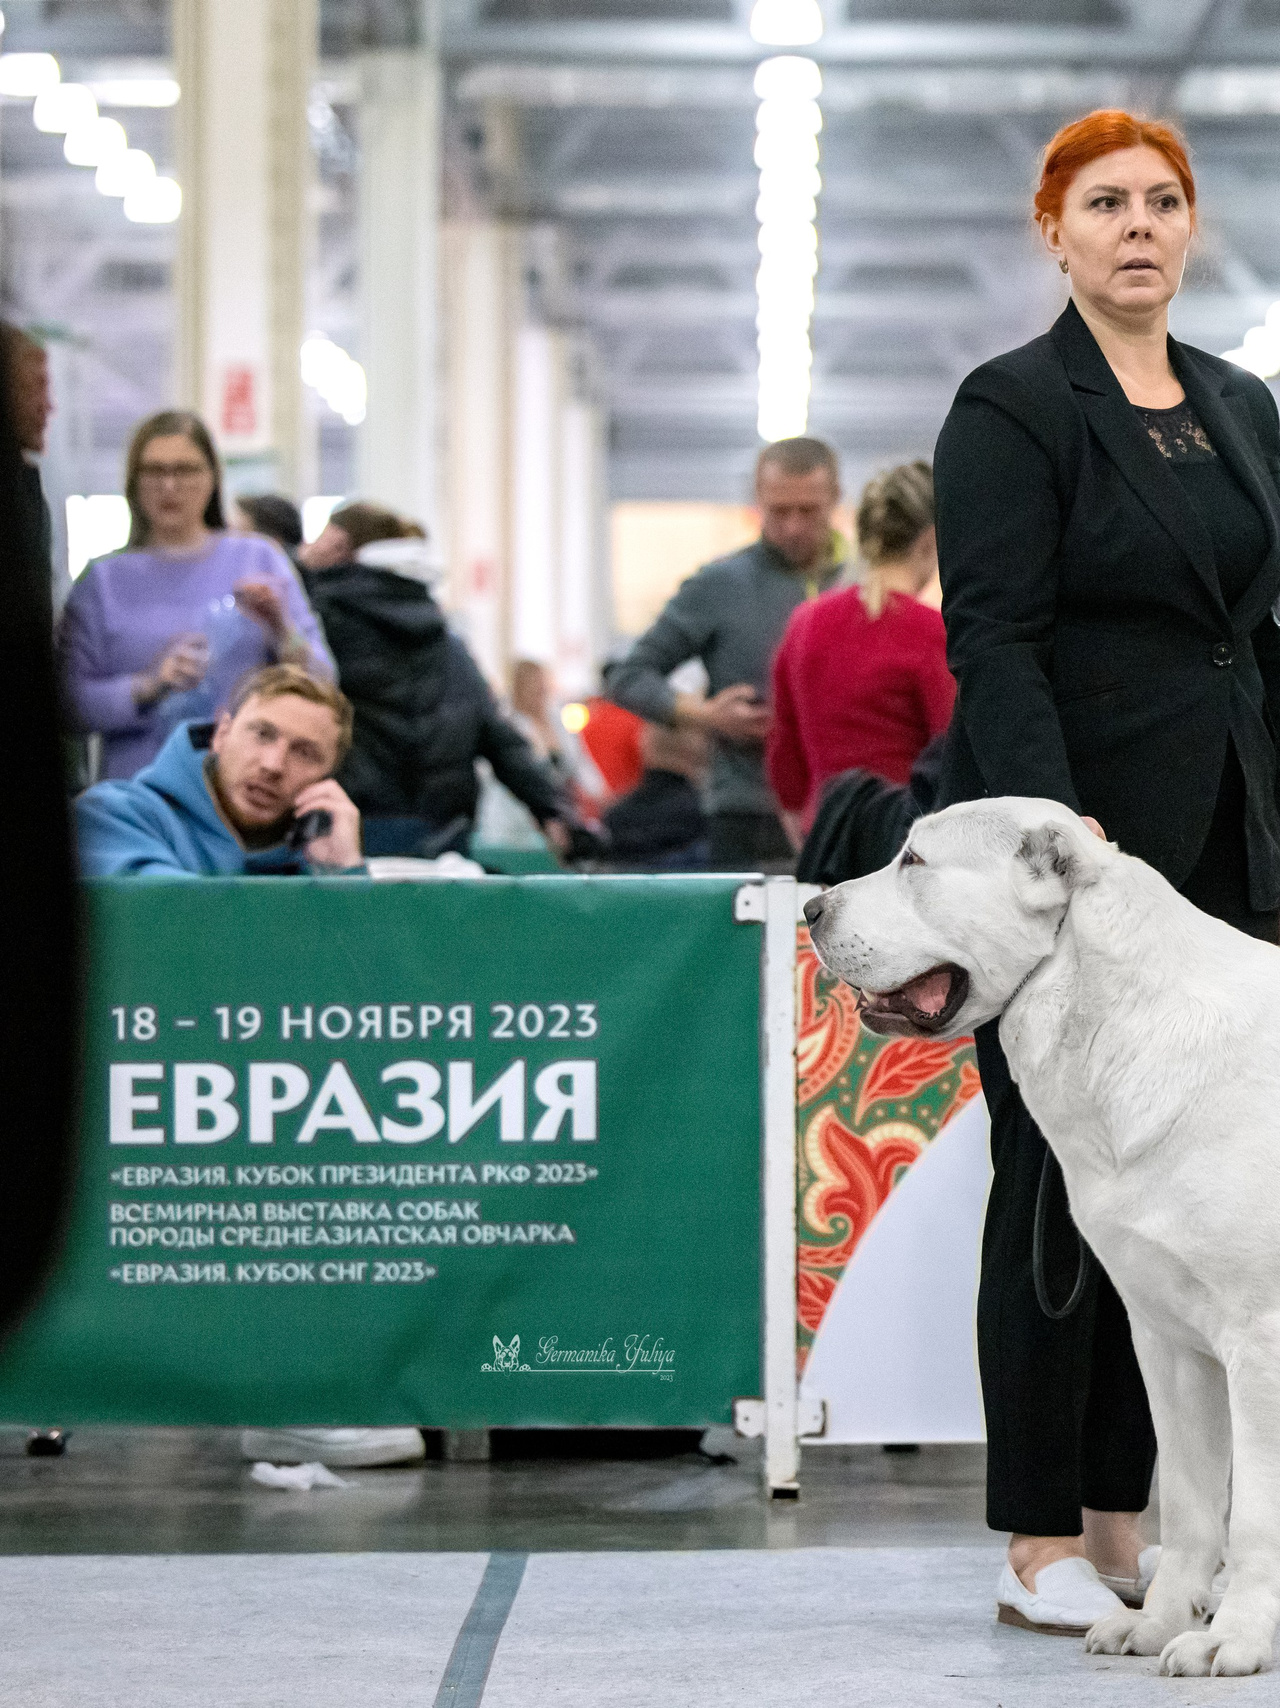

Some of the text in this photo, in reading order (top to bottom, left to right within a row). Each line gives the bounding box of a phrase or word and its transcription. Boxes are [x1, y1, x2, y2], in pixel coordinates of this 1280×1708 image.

[112, 1006, 157, 1041] 18
[215, 1006, 262, 1040] 19
[282, 1004, 473, 1039] НОЯБРЯ
[492, 1003, 598, 1038] 2023
[109, 1059, 597, 1145] ЕВРАЗИЯ
[236, 1165, 315, 1186] КУБОК
[320, 1163, 478, 1187] ПРЕЗИДЕНТА
[481, 1163, 531, 1184] РКФ
[535, 1162, 598, 1184] 2023»
[110, 1200, 480, 1223] ВСЕМИРНАЯ ВЫСТАВКА СОБАК
[110, 1223, 575, 1248] ПОРОДЫ СРЕДНЕАЗИАТСКАЯ ОВЧАРКА
[236, 1262, 315, 1283] КУБОК
[319, 1261, 368, 1282] СНГ
[373, 1261, 436, 1282] 2023»
